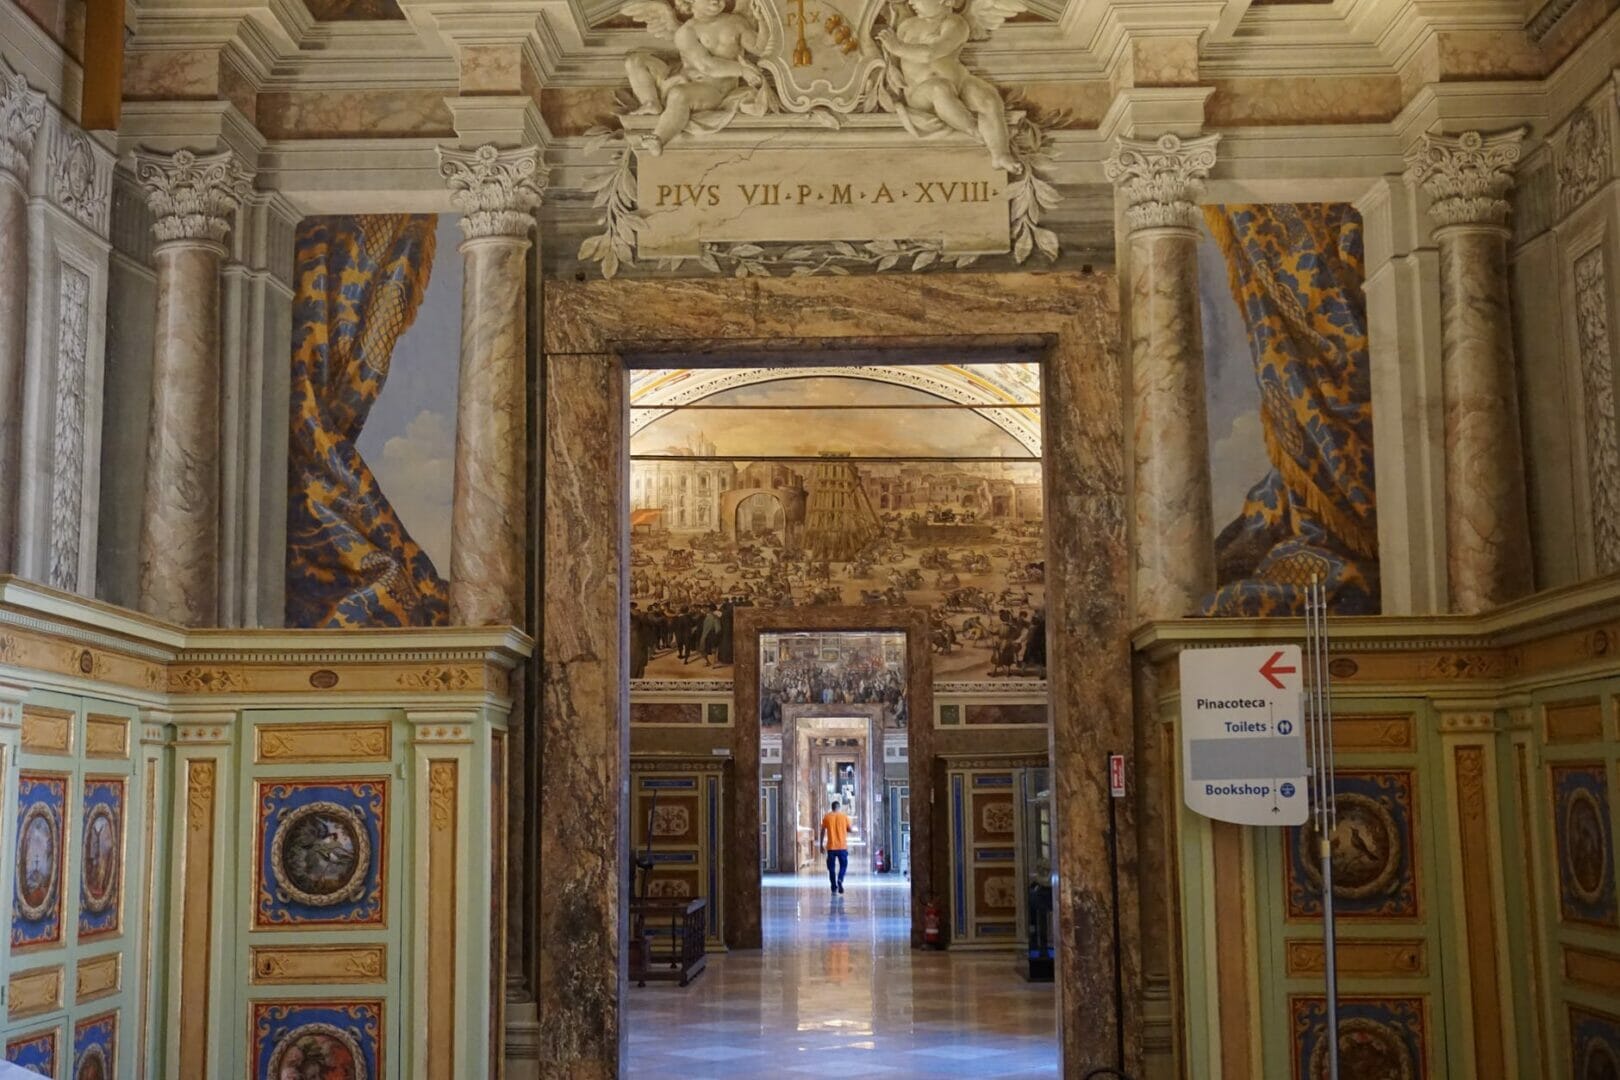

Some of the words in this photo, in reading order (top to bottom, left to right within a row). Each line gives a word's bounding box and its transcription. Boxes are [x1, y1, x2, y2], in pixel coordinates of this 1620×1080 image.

[655, 184, 721, 207] PIVS
[1197, 698, 1266, 709] Pinacoteca
[1225, 721, 1267, 732] Toilets
[1205, 784, 1270, 797] Bookshop
